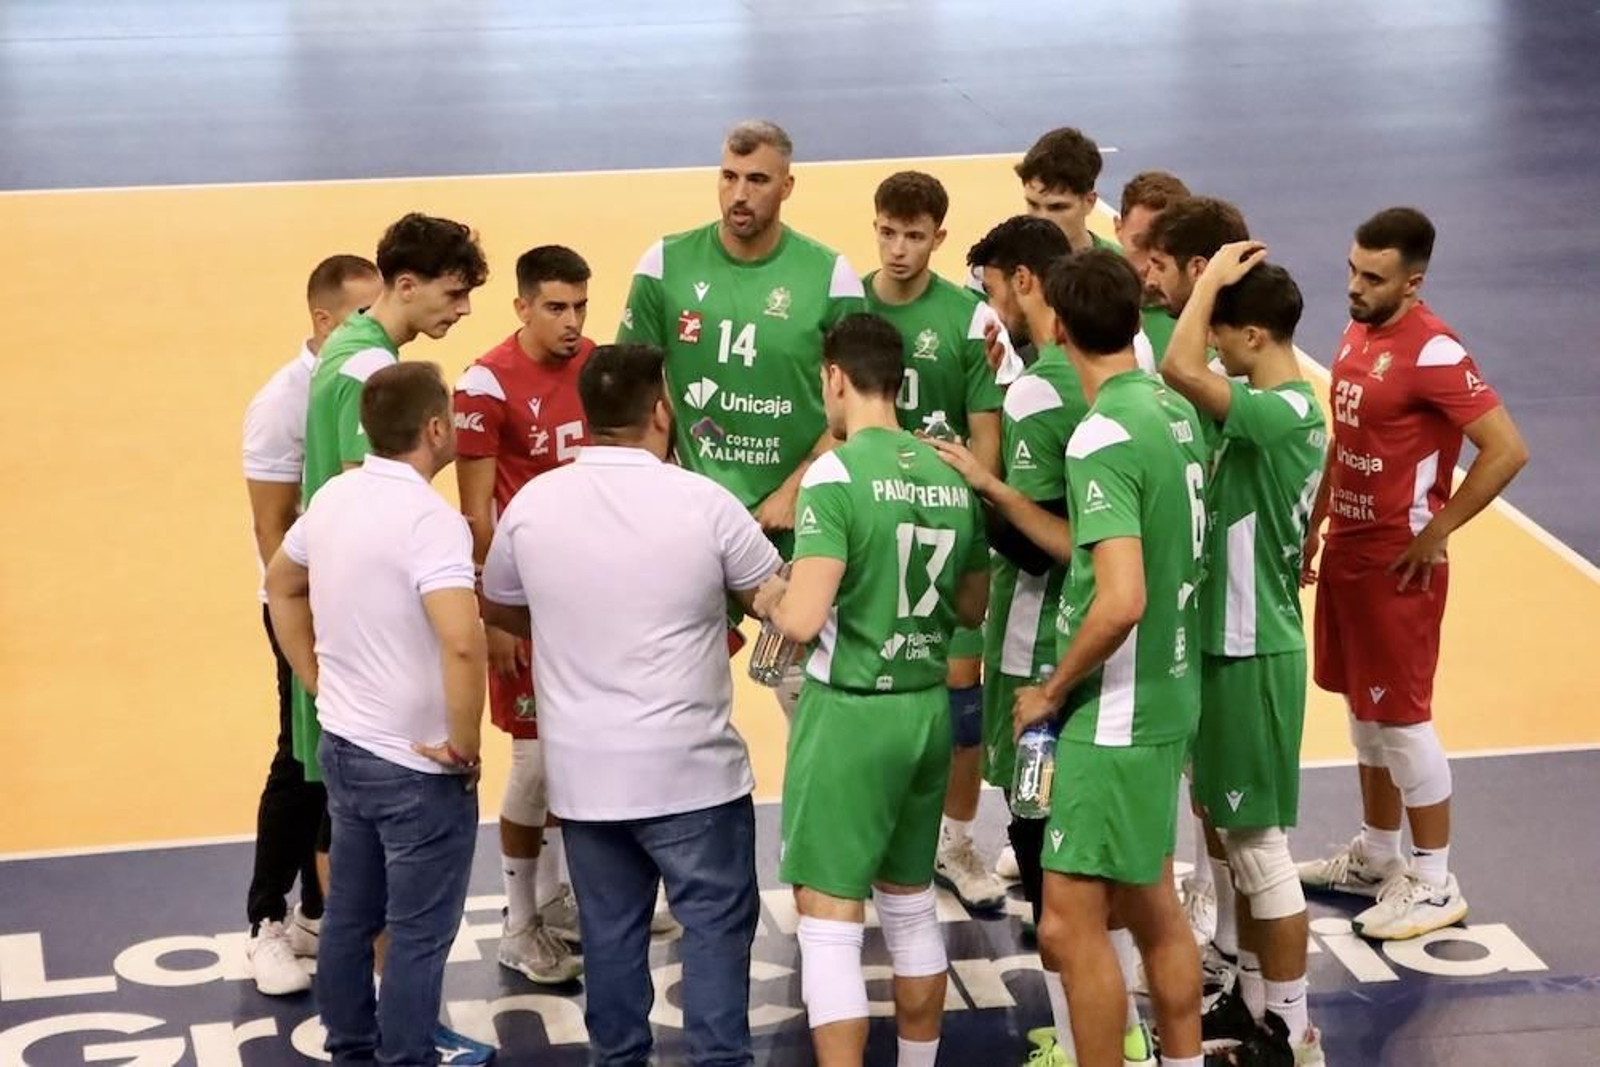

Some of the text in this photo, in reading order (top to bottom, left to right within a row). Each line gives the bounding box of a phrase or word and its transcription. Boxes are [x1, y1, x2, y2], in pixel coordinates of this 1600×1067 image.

[718, 319, 757, 367] 14
[720, 391, 792, 418] Unicaja
[1335, 379, 1363, 428] 22
[714, 447, 780, 465] ALMERÍA
[726, 434, 780, 448] COSTA DE
[1185, 462, 1206, 561] 6
[896, 522, 956, 619] 17
[0, 931, 256, 1001] La
